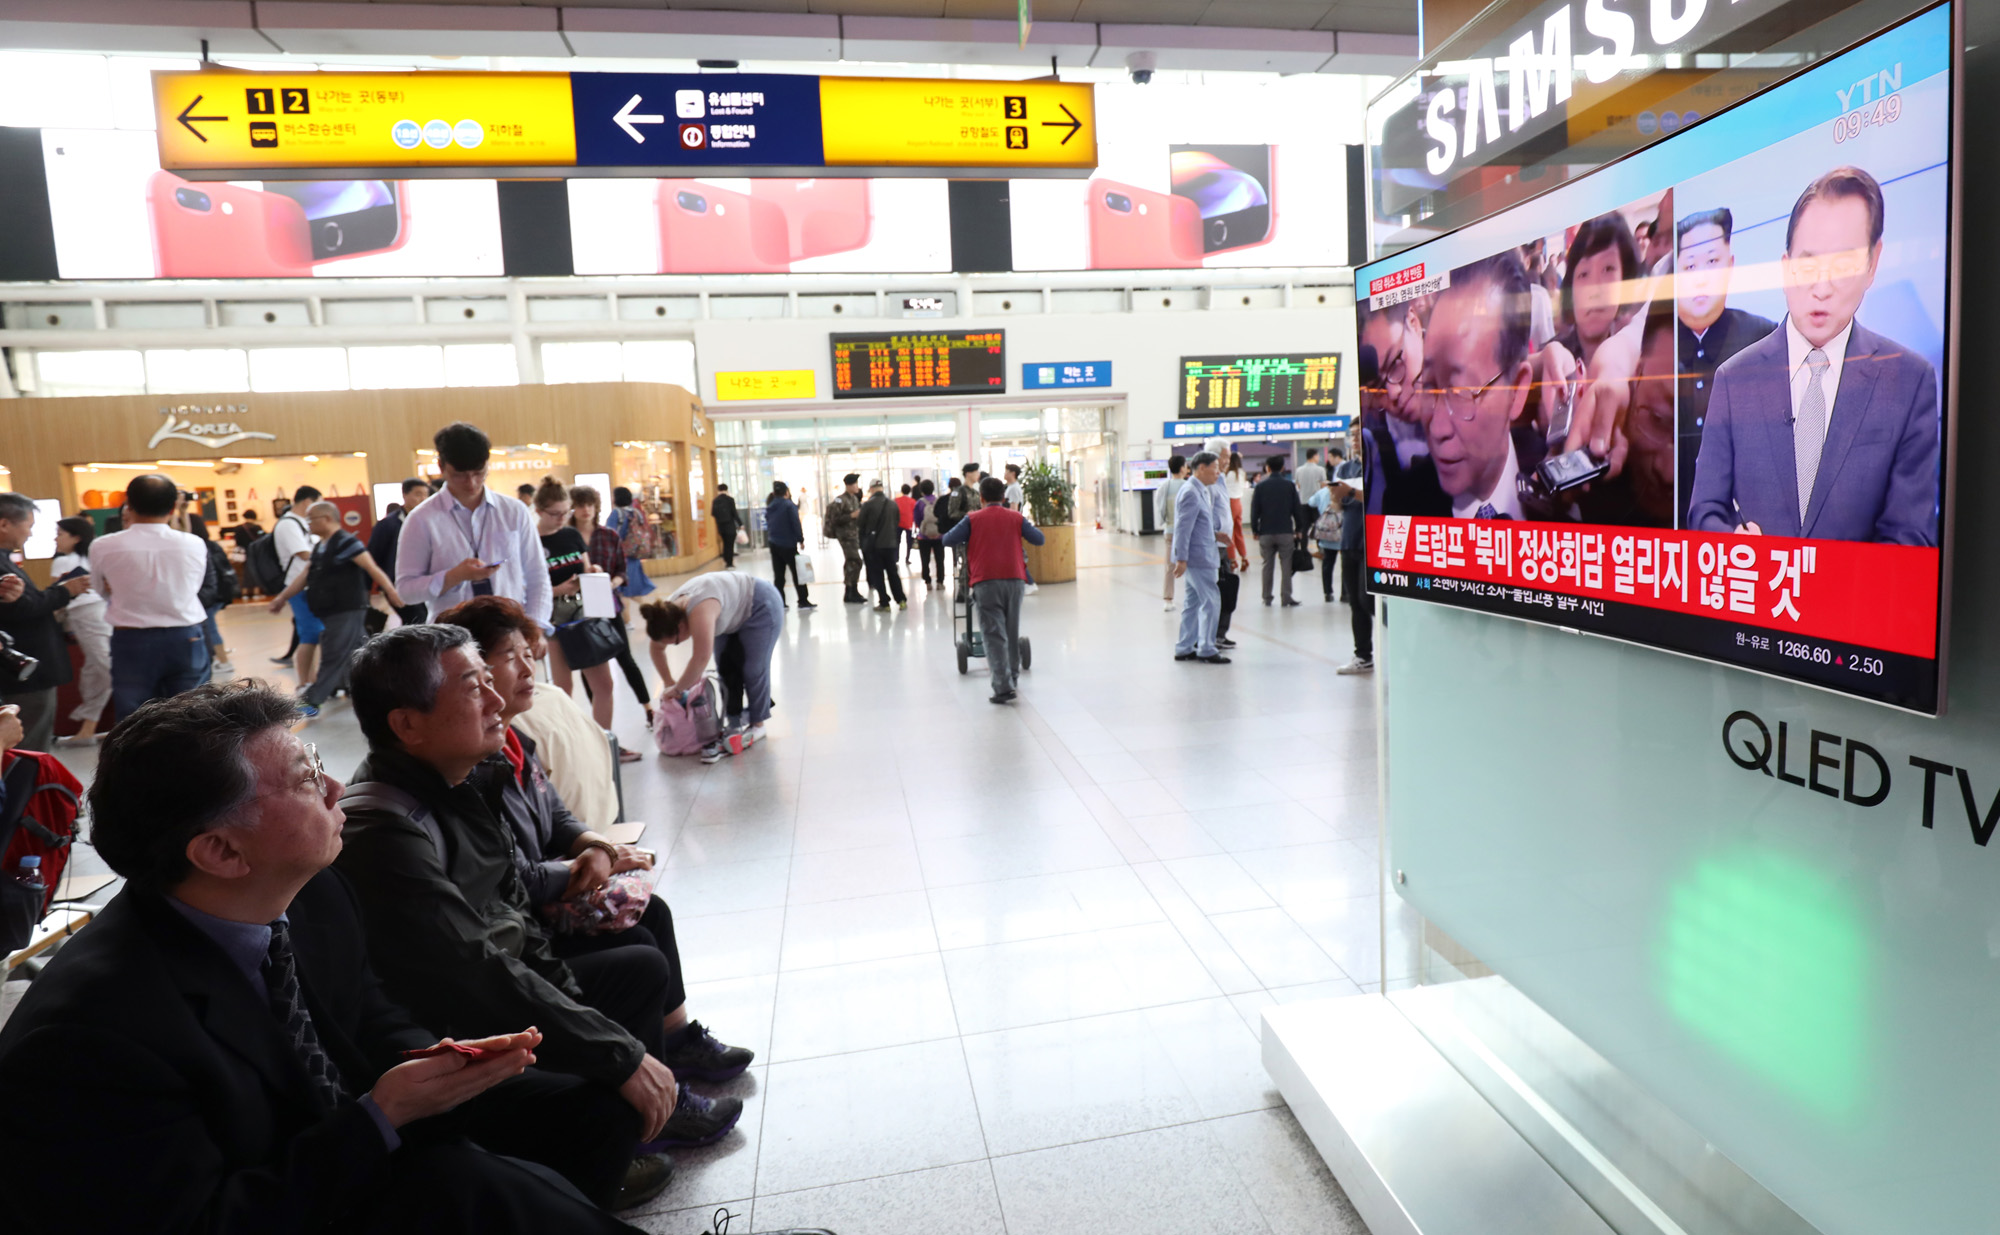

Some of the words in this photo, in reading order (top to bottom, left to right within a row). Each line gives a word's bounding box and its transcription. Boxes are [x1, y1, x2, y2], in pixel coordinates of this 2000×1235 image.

[1835, 62, 1903, 113] YTN
[254, 92, 266, 111] 1
[288, 91, 304, 111] 2
[316, 90, 352, 104] 나가는
[359, 90, 404, 104] 곳(동부)
[923, 96, 955, 109] 나가는
[960, 96, 999, 110] 곳(서부)
[710, 107, 725, 115] Lost
[731, 107, 754, 115] Found
[1010, 99, 1022, 118] 3
[1833, 93, 1903, 144] 09:49
[284, 123, 356, 136] 버스환승센터
[489, 124, 523, 136] 지하철
[960, 126, 999, 138] 공항철도
[711, 140, 750, 149] Information
[1371, 279, 1384, 292] 회담
[1384, 276, 1395, 289] 취소
[1403, 268, 1410, 282] 첫
[1410, 265, 1423, 280] 반응
[1064, 366, 1081, 377] 타는
[1085, 365, 1094, 377] 곳
[730, 377, 762, 389] 나오는
[770, 376, 779, 388] 곳
[148, 414, 276, 449] KOREA
[1268, 422, 1291, 431] Tickets
[1387, 520, 1406, 535] 뉴스
[1384, 538, 1403, 554] 속보
[1414, 524, 1465, 569] 트럼프
[1468, 523, 1513, 577] "북미
[1518, 529, 1606, 589] 정상회담
[1611, 535, 1688, 603] 열리지
[1697, 542, 1759, 615] 않을
[1768, 546, 1817, 622] 것"
[1388, 573, 1409, 588] YTN
[1416, 577, 1431, 591] 사회
[1776, 640, 1832, 665] 1266.60
[1849, 654, 1884, 676] 2.50
[1722, 710, 1892, 807] QLED
[1908, 755, 2000, 847] TV
